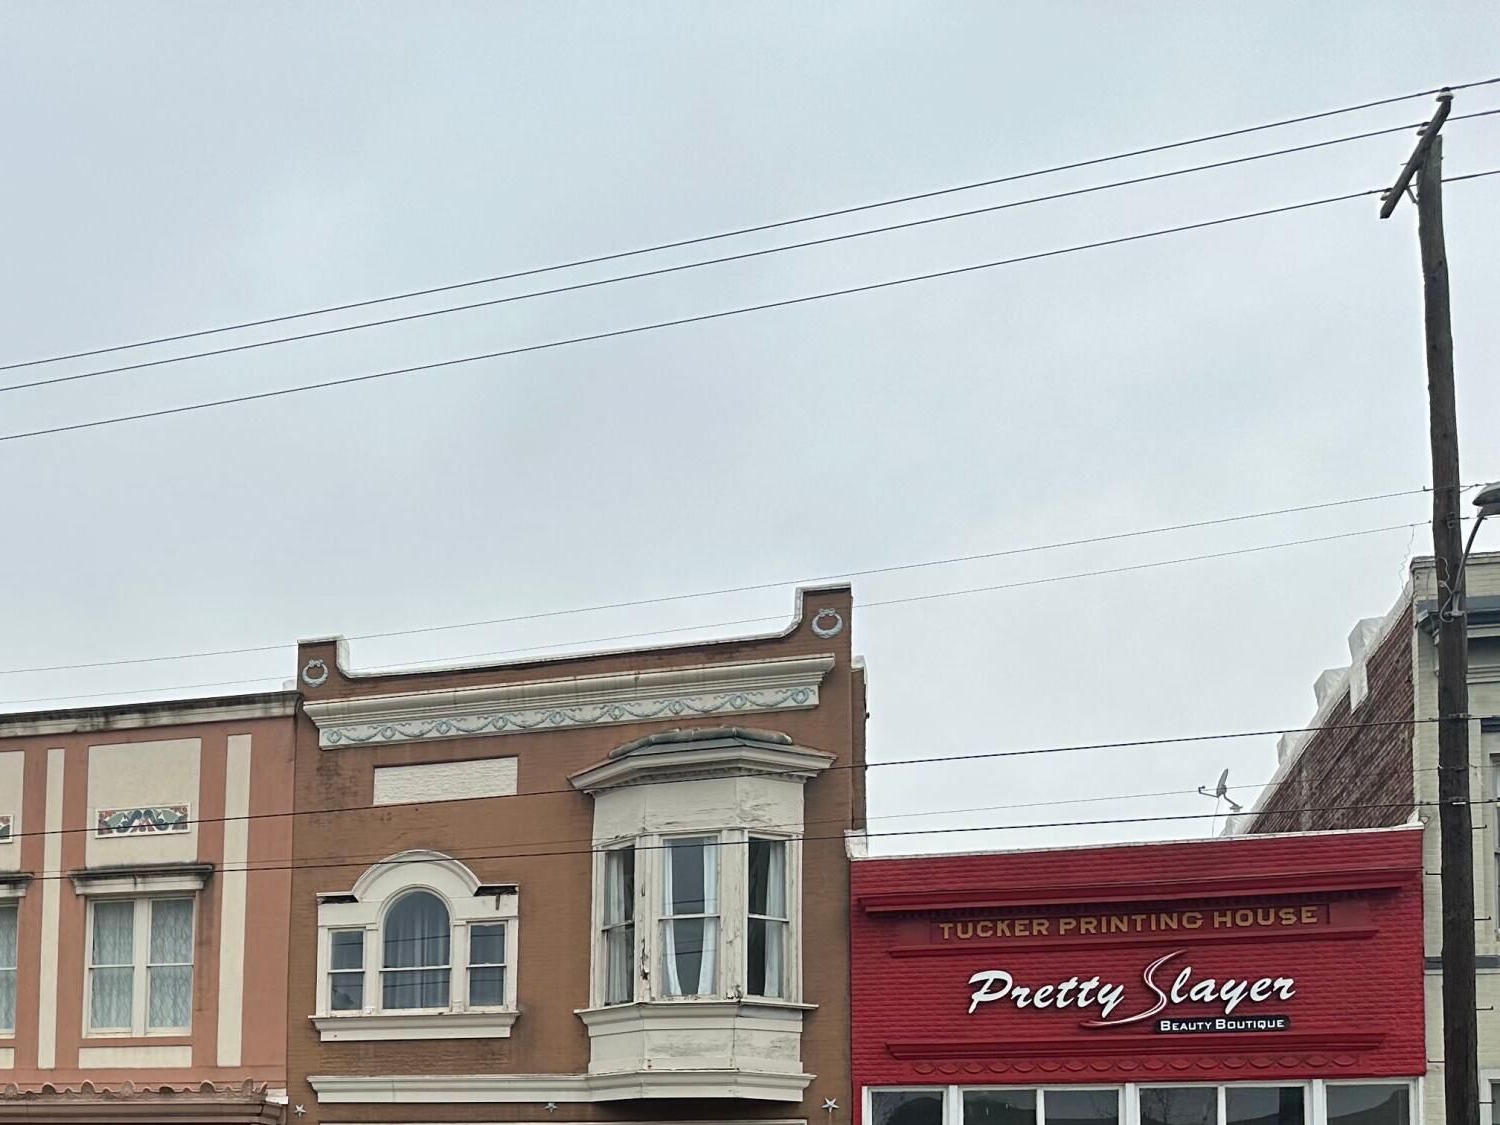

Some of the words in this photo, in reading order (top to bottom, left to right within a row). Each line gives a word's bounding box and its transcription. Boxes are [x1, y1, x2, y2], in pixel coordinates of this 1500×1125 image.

[939, 918, 1050, 940] TUCKER
[1059, 910, 1204, 936] PRINTING
[1213, 906, 1318, 929] HOUSE
[968, 970, 1125, 1019] Pretty
[1084, 949, 1296, 1028] Slayer
[1159, 1020, 1212, 1032] BEAUTY
[1215, 1018, 1285, 1030] BOUTIQUE
